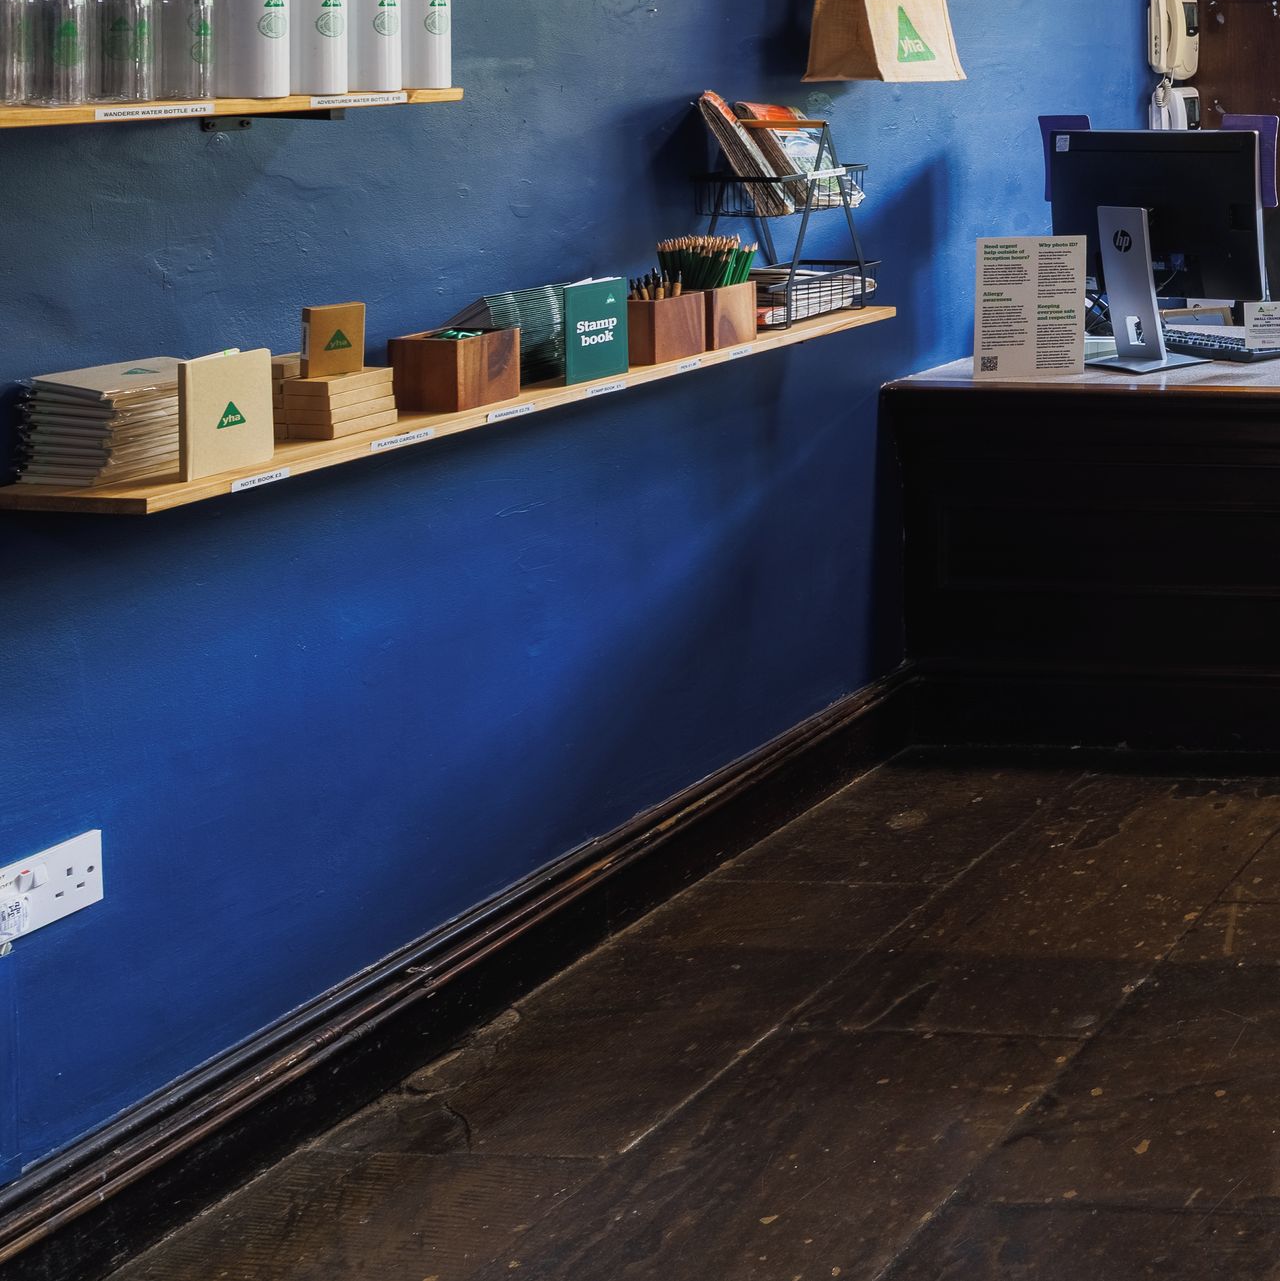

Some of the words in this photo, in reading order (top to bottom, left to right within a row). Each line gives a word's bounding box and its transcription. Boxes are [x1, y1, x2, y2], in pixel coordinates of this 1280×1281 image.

[900, 36, 926, 58] yha
[103, 109, 140, 118] WANDERER
[140, 108, 164, 117] WATER
[164, 107, 189, 116] BOTTLE
[1115, 229, 1130, 253] hp
[576, 316, 617, 334] Stamp
[581, 330, 614, 348] book
[222, 412, 242, 426] yha
[377, 438, 399, 449] PLAYING
[240, 480, 256, 489] NOTE
[257, 475, 274, 485] BOOK
